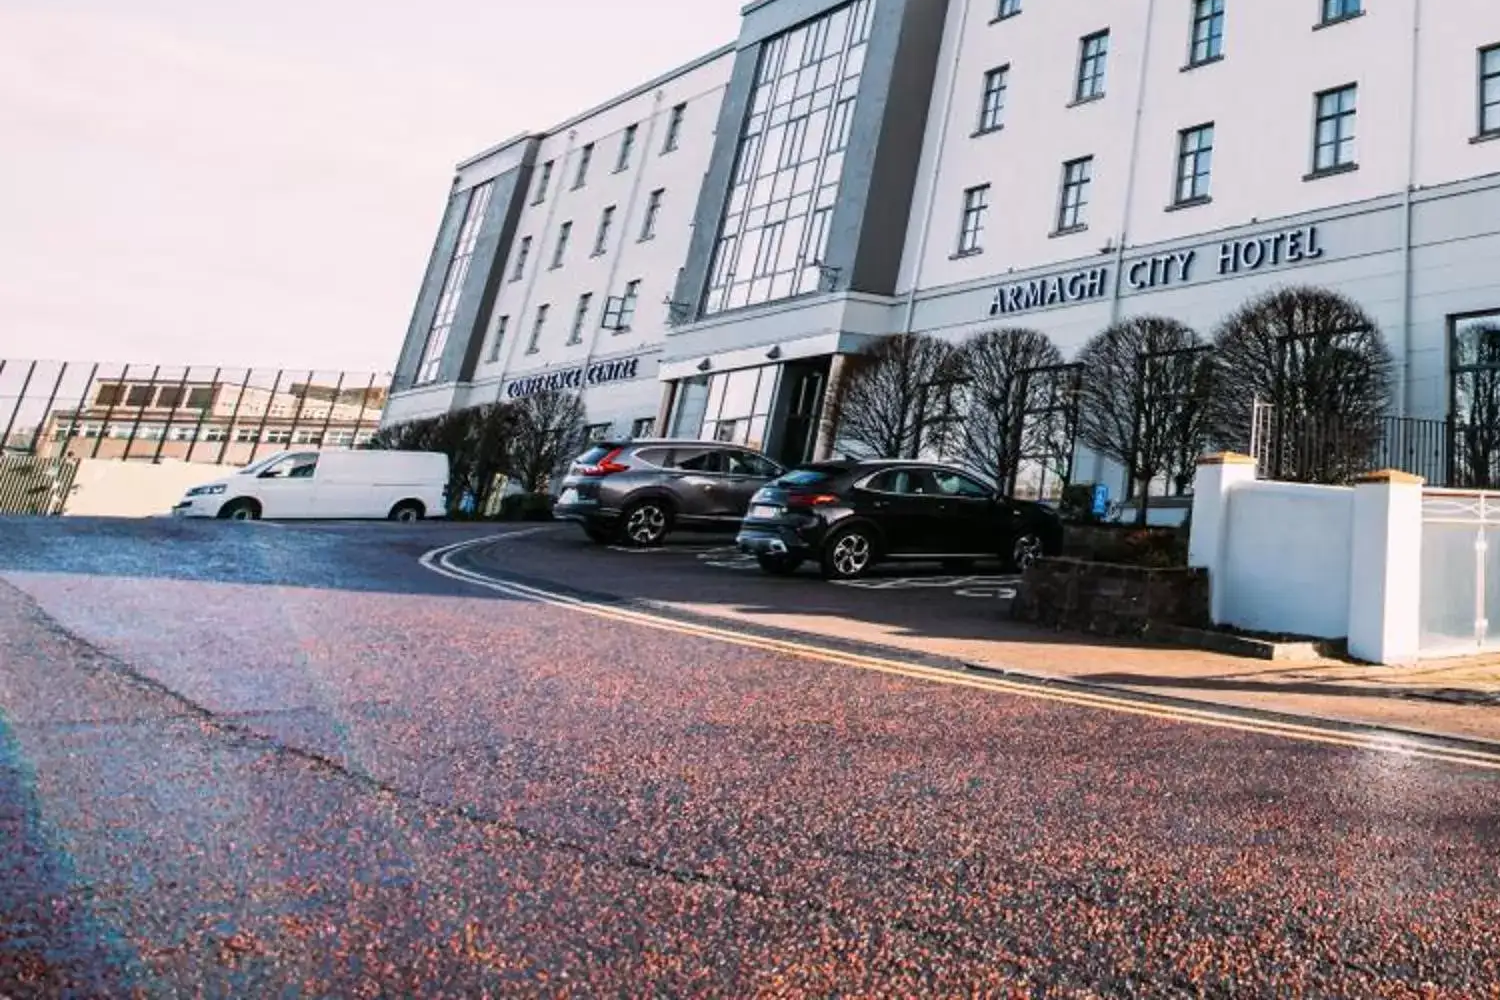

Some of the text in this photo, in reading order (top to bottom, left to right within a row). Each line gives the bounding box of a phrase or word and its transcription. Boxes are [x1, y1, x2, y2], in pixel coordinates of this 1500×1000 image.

[988, 226, 1323, 315] ARMAGH CITY HOTEL
